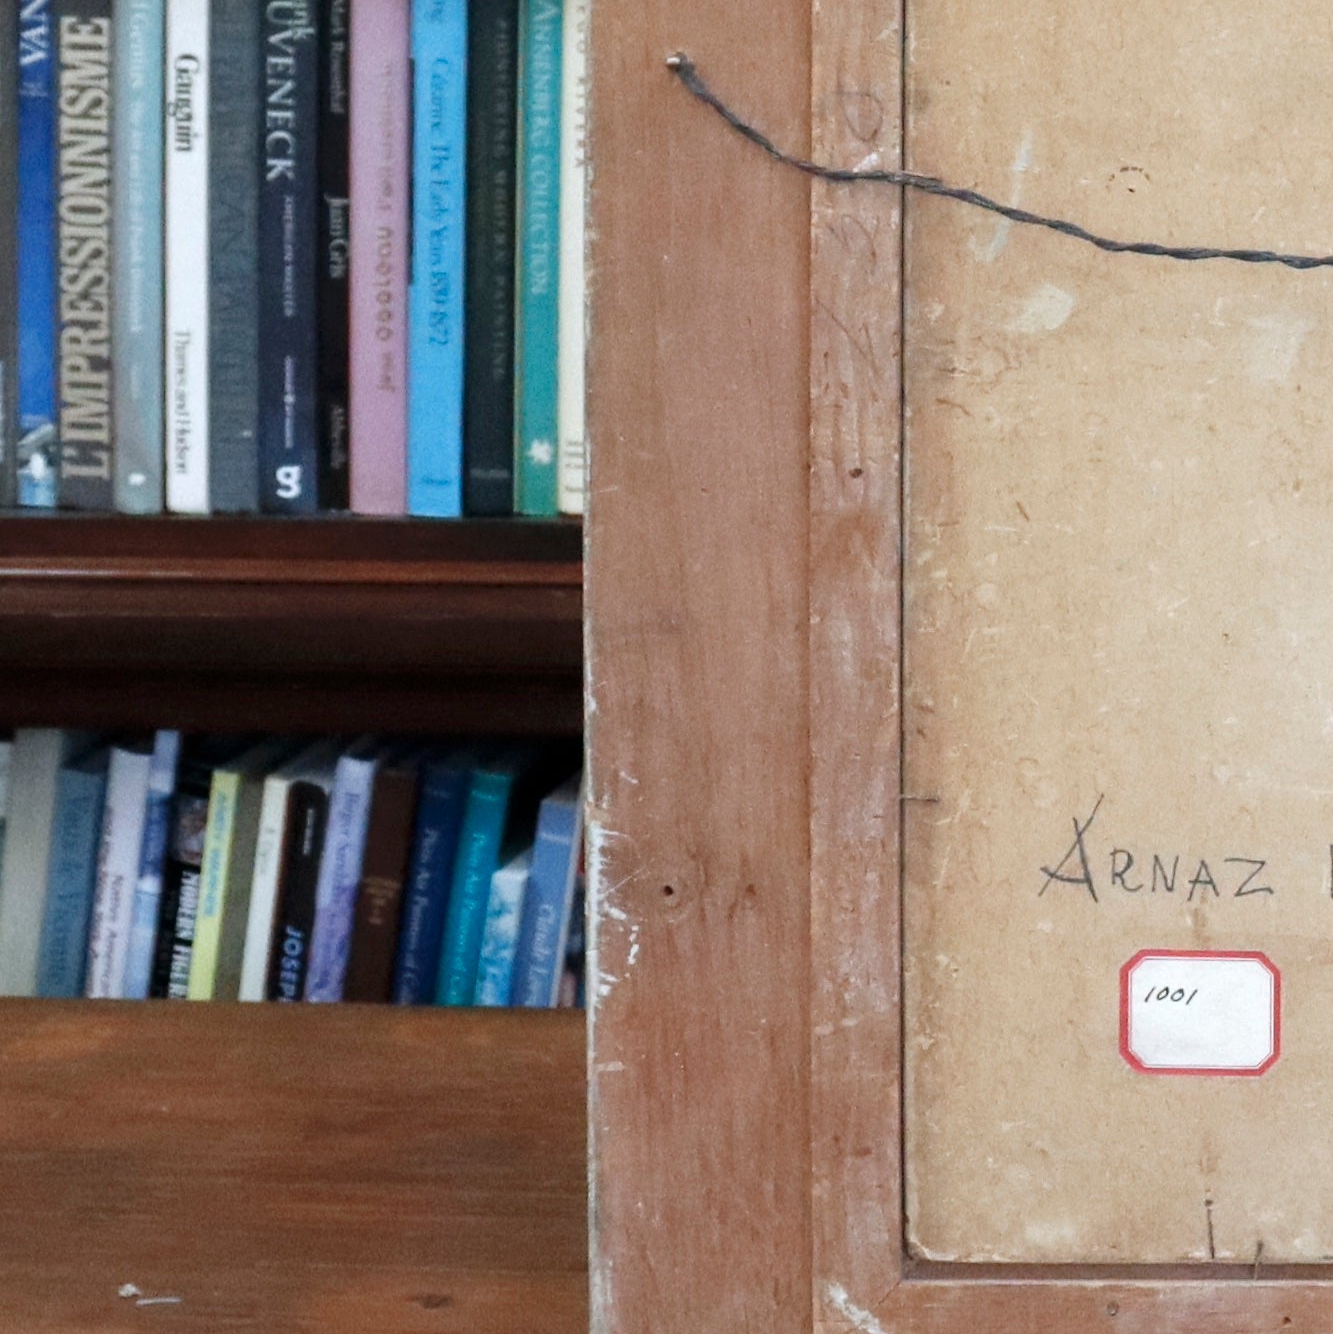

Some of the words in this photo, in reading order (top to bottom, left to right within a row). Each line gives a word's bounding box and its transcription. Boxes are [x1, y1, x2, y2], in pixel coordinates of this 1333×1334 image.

[168, 52, 201, 153] Gauguin
[58, 15, 110, 482] L'IMPRESSIONNISME
[323, 194, 349, 235] Juan
[529, 154, 553, 297] COLLECTION
[328, 236, 349, 279] Gris
[174, 388, 192, 417] and
[1038, 792, 1276, 904] ARNAZ
[1143, 985, 1199, 1006] 1001
